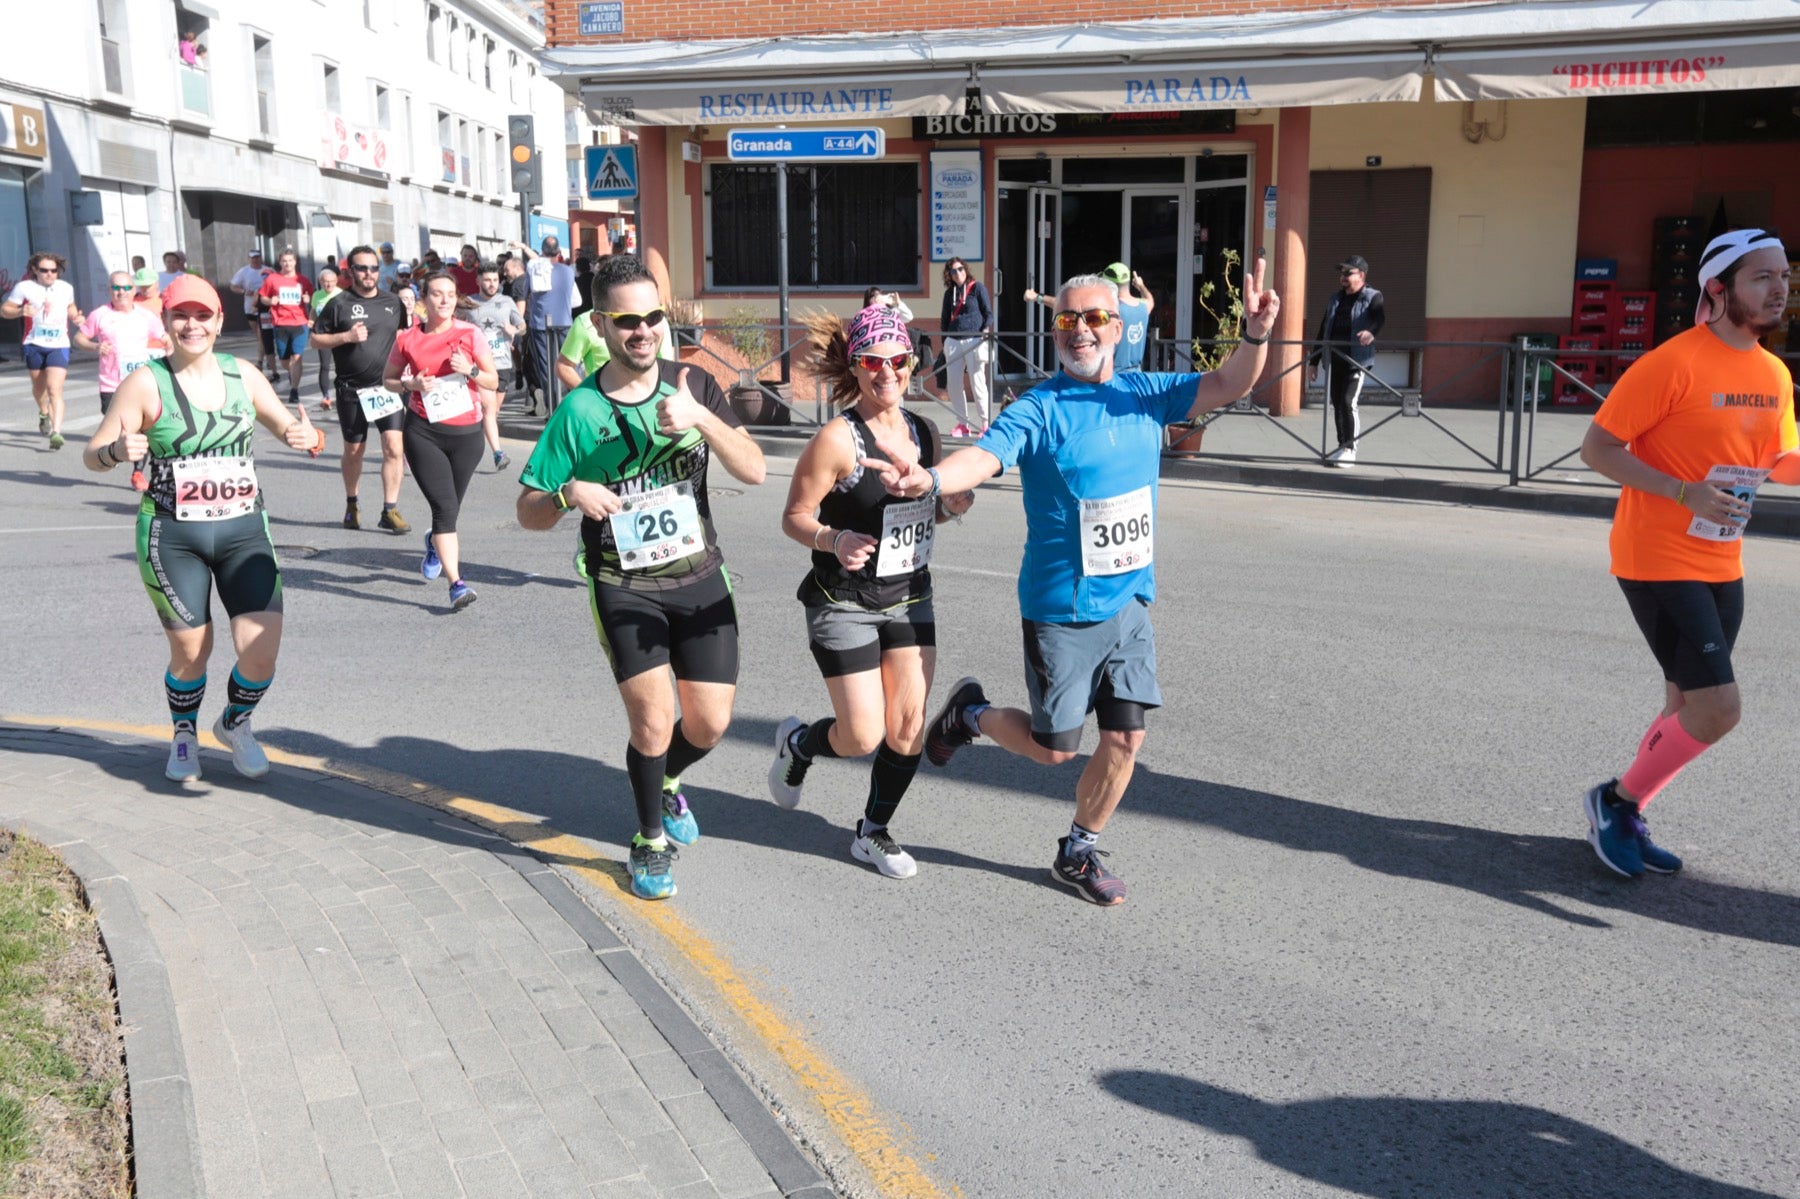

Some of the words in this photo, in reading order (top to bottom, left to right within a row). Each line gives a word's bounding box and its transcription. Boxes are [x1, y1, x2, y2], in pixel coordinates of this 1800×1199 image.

[590, 4, 620, 12] AVENIDA
[592, 12, 618, 22] JACOBO
[582, 22, 622, 32] CAMARERO
[1124, 76, 1251, 104] PARADA
[700, 88, 893, 118] RESTAURANTE
[22, 115, 39, 147] B
[926, 113, 1057, 134] BICHITOS
[732, 138, 792, 151] Granada
[367, 395, 394, 409] 704
[1724, 393, 1779, 408] MARCELINO
[181, 477, 254, 502] 2069
[639, 509, 678, 543] 26
[891, 518, 933, 549] 3095
[1093, 513, 1150, 548] 3096
[150, 537, 159, 547] DE
[150, 547, 164, 572] MENTE
[157, 571, 170, 587] QUE
[164, 586, 176, 597] DE
